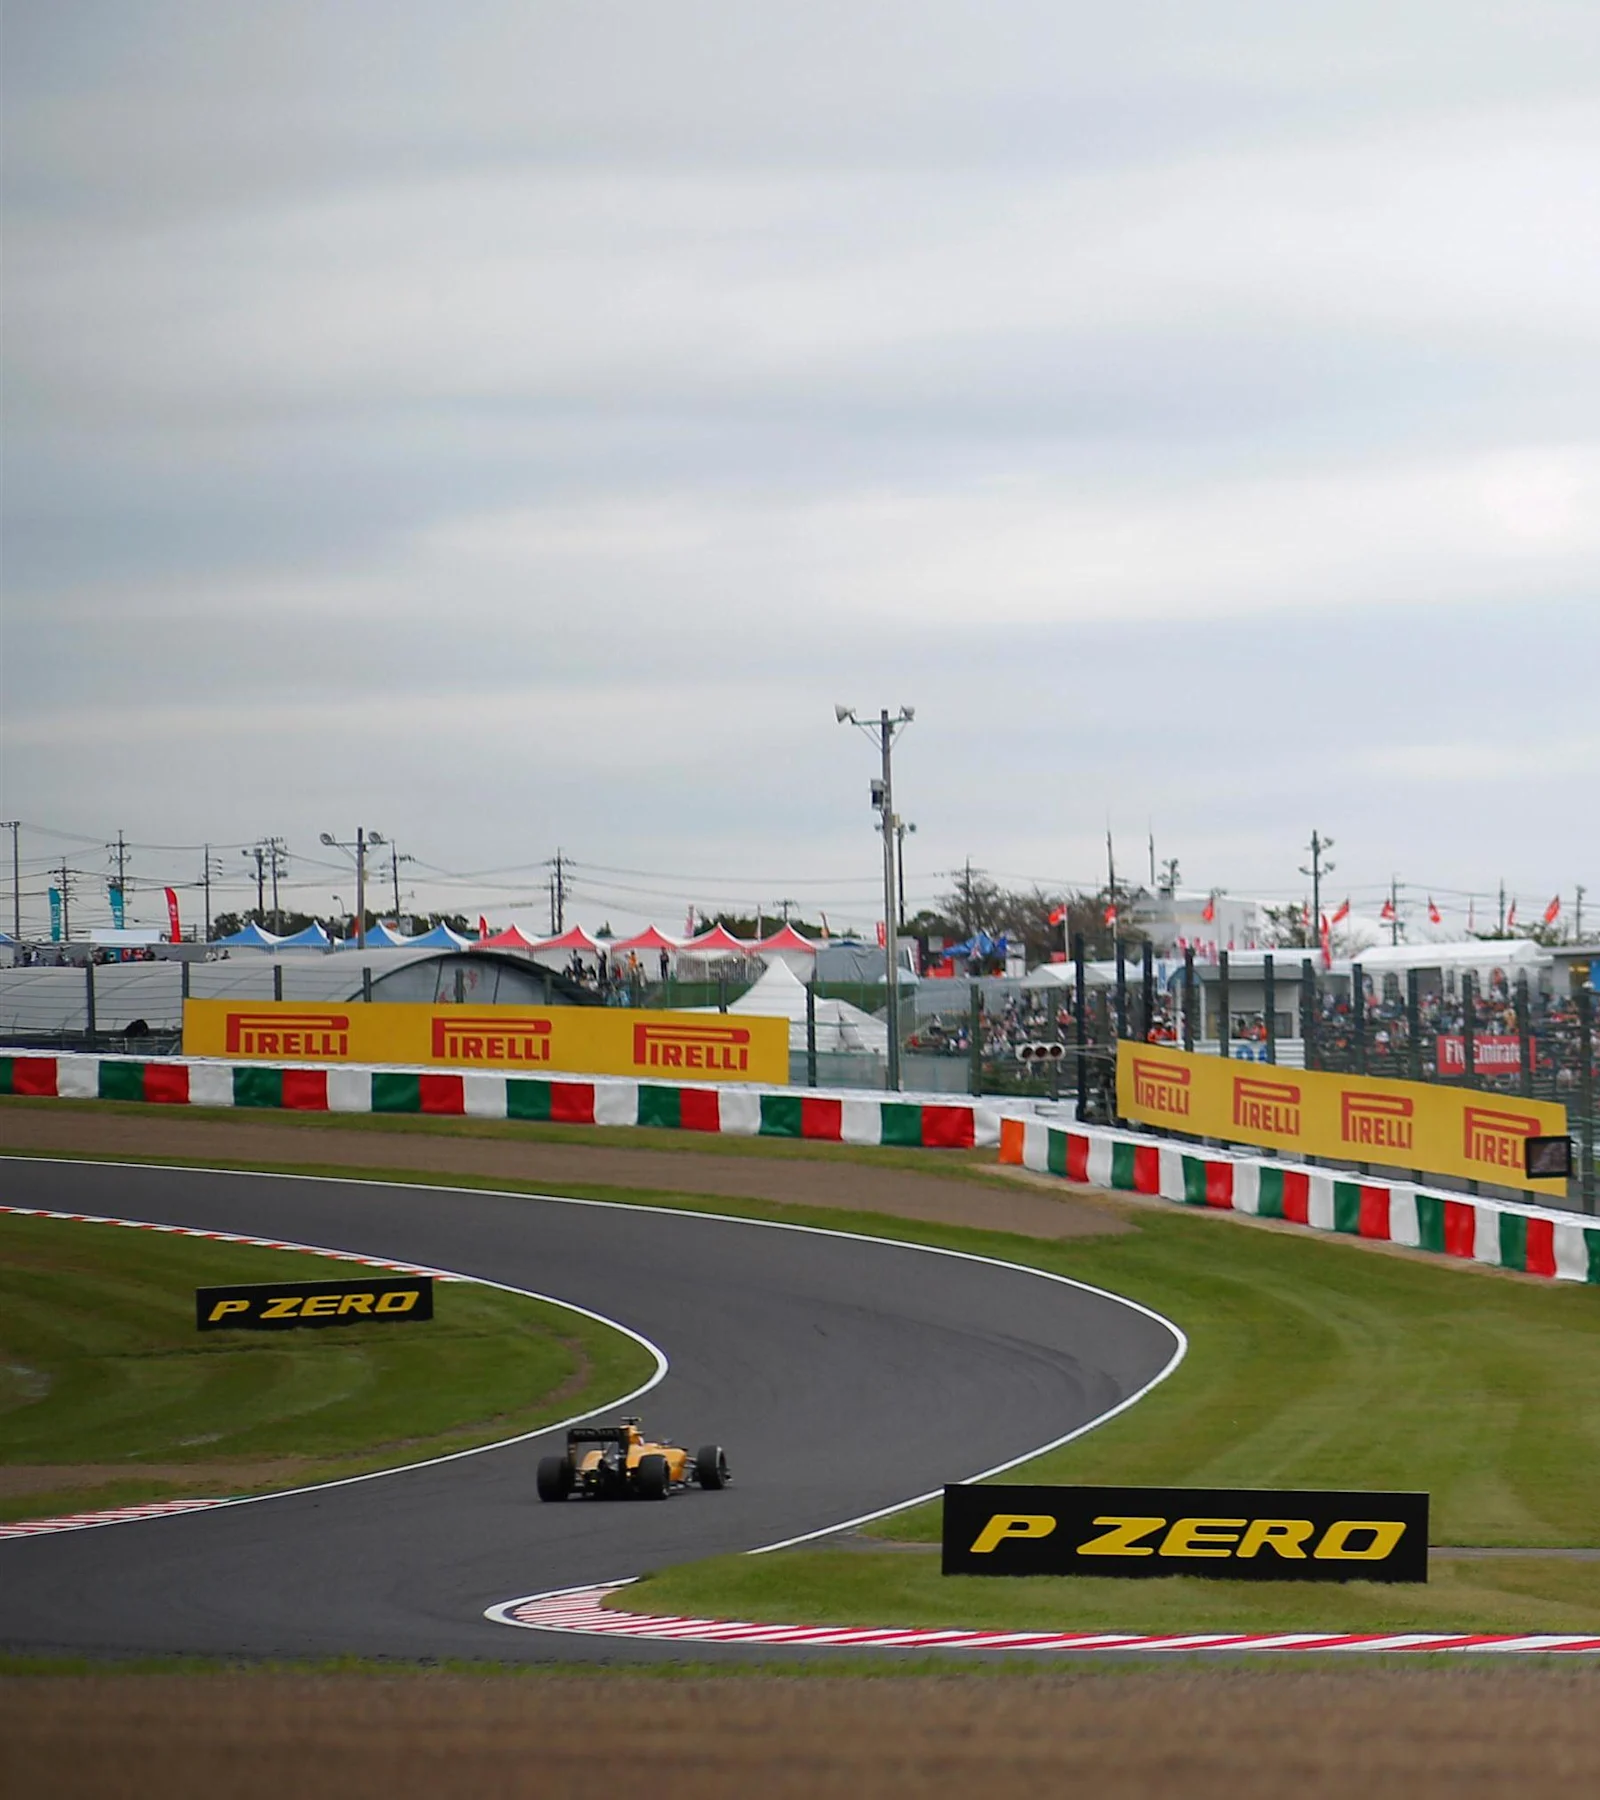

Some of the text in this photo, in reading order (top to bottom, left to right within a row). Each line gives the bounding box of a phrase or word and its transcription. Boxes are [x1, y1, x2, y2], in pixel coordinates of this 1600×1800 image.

[226, 1013, 349, 1055] PIRELLI
[432, 1018, 552, 1060] PIRELLI
[633, 1022, 750, 1070] PIRELLI
[1473, 1038, 1521, 1064] Emirate
[1133, 1058, 1191, 1116] PIRELLI
[1233, 1075, 1301, 1136] PIRELLI
[1341, 1091, 1414, 1149] PIRELLI
[1463, 1106, 1541, 1169] PIREL
[208, 1291, 419, 1321] P ZERO
[970, 1514, 1406, 1560] P ZERO
